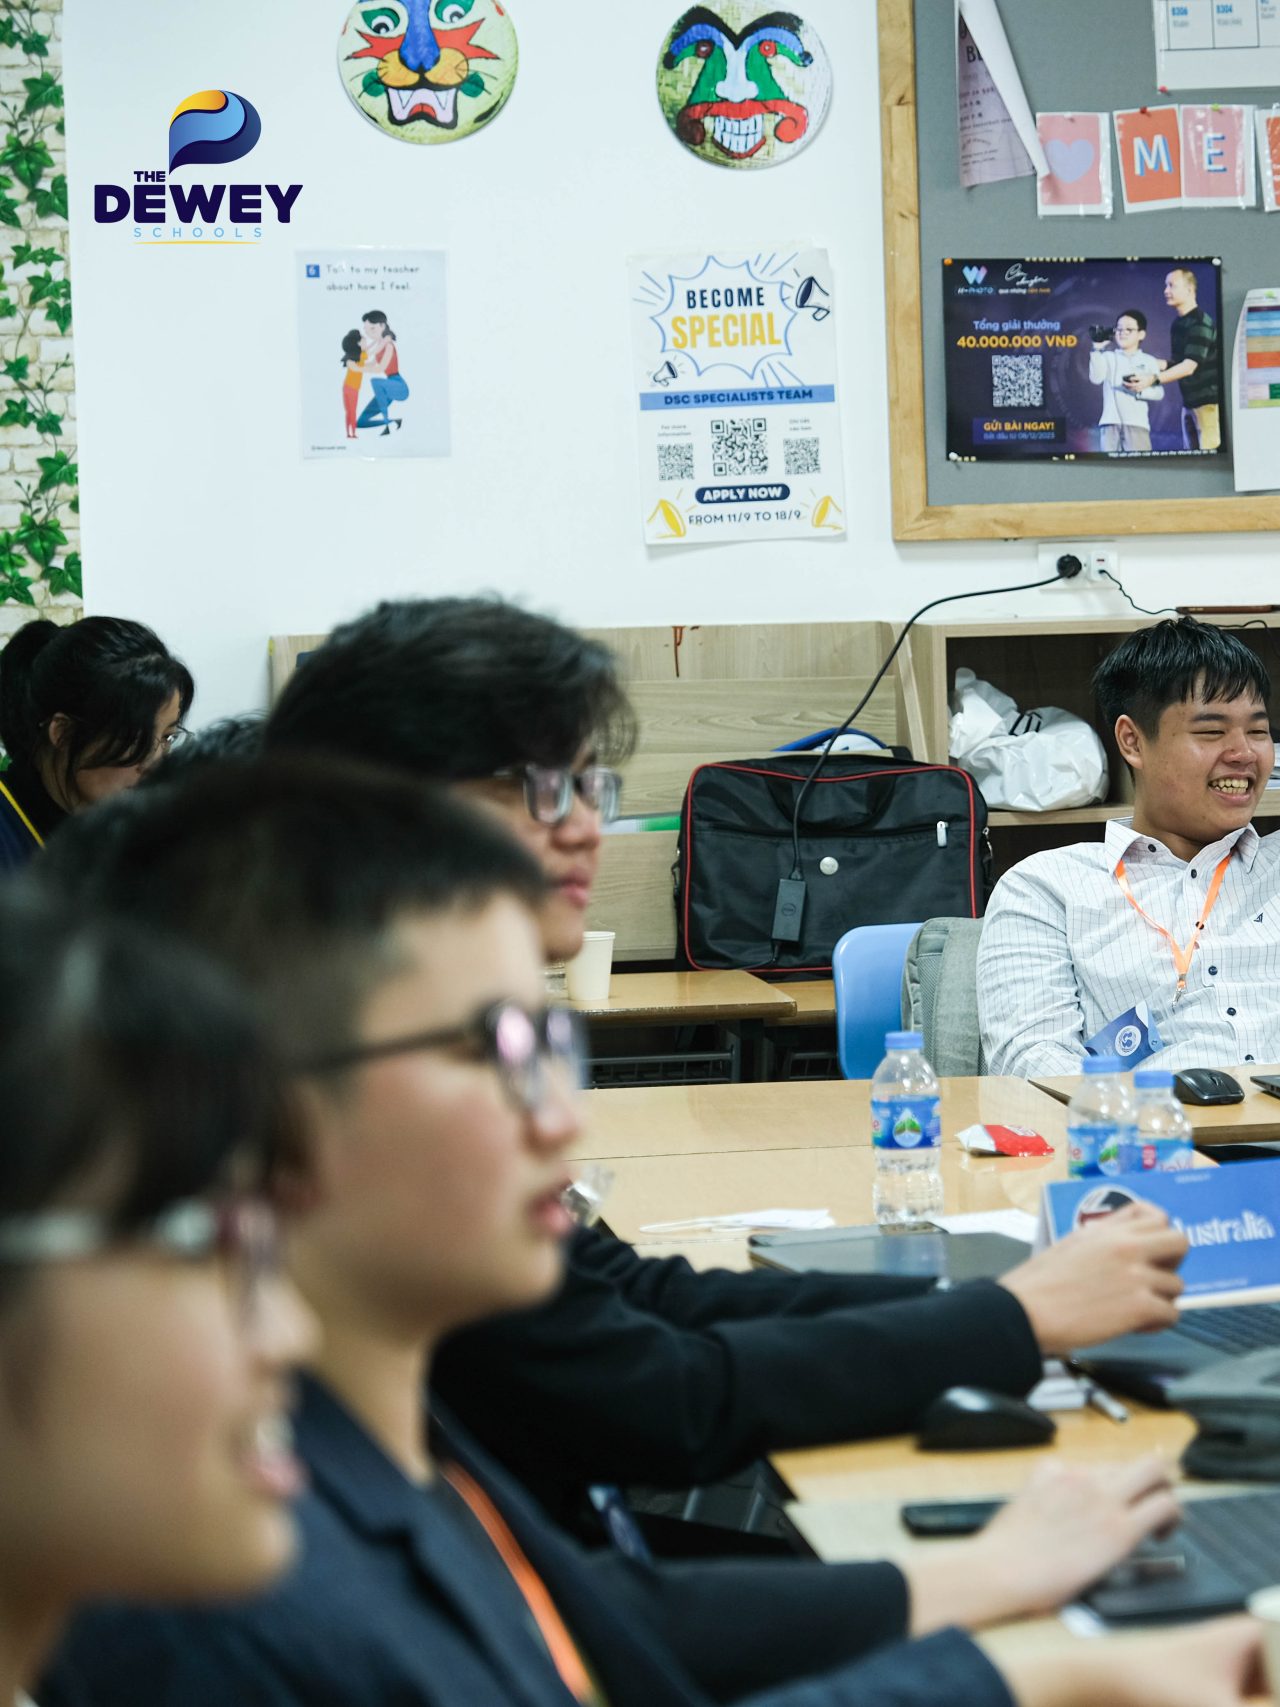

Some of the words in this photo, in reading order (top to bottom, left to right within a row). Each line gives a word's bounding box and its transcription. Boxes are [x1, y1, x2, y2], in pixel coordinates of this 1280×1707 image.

[326, 264, 345, 274] Ta
[686, 287, 765, 309] BECOME
[671, 312, 782, 349] SPECIAL
[957, 335, 1042, 348] 40.000.000
[664, 394, 690, 405] DSC
[693, 390, 774, 404] SPECIALISTS
[777, 389, 813, 400] TEAM
[702, 489, 745, 502] APPLY
[748, 486, 783, 499] NOW
[688, 514, 724, 525] FROM
[727, 512, 751, 523] 11/9
[755, 511, 771, 521] TO
[775, 510, 801, 521] 18/9
